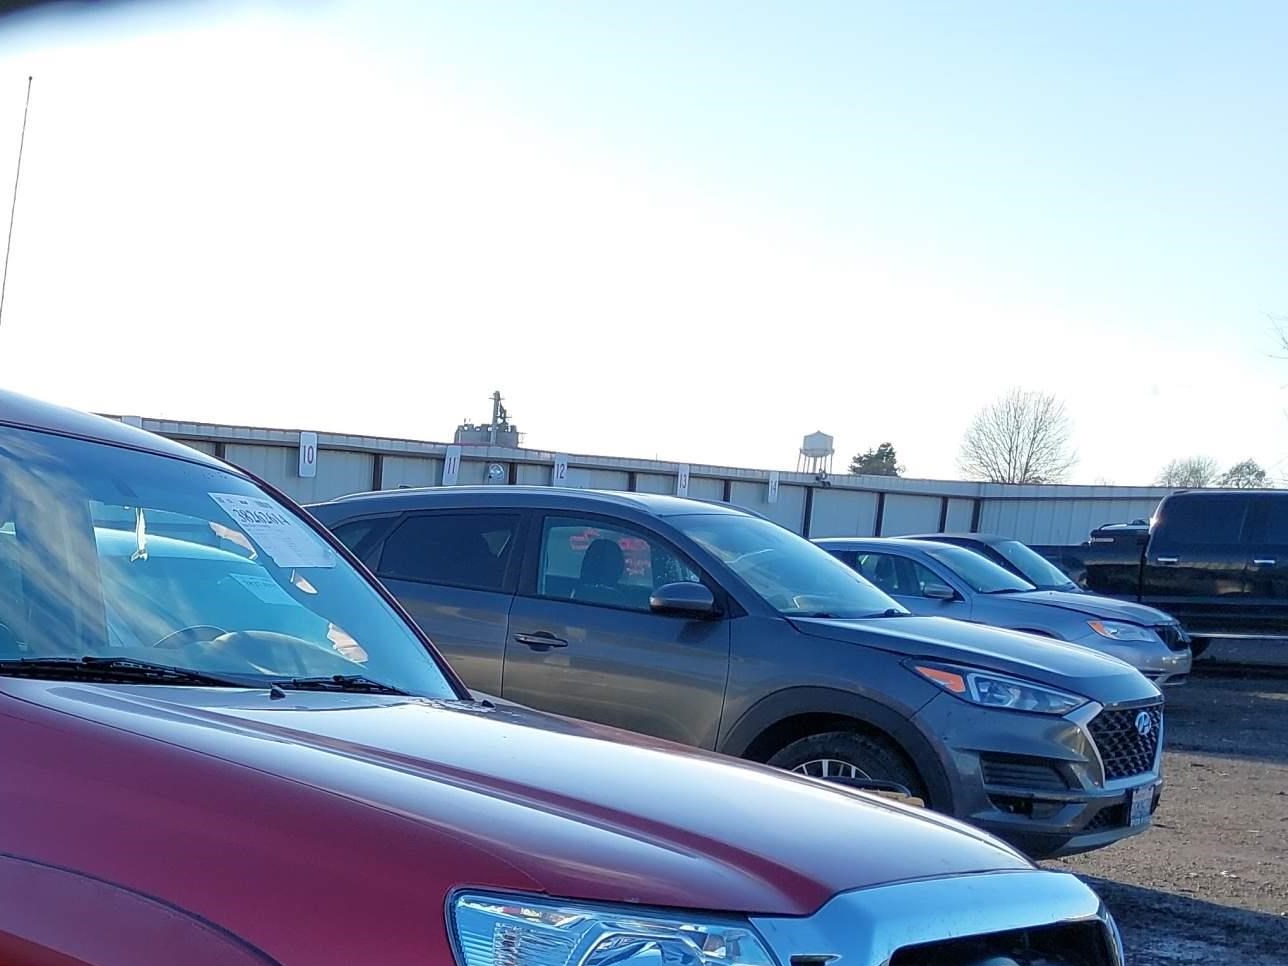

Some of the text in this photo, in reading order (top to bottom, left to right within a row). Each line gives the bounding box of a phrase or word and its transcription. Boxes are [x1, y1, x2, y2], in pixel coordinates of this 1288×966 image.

[303, 445, 314, 464] 10
[447, 457, 458, 475] 11
[555, 463, 565, 479] 12
[680, 473, 687, 489] 13
[232, 508, 292, 526] 38262614
